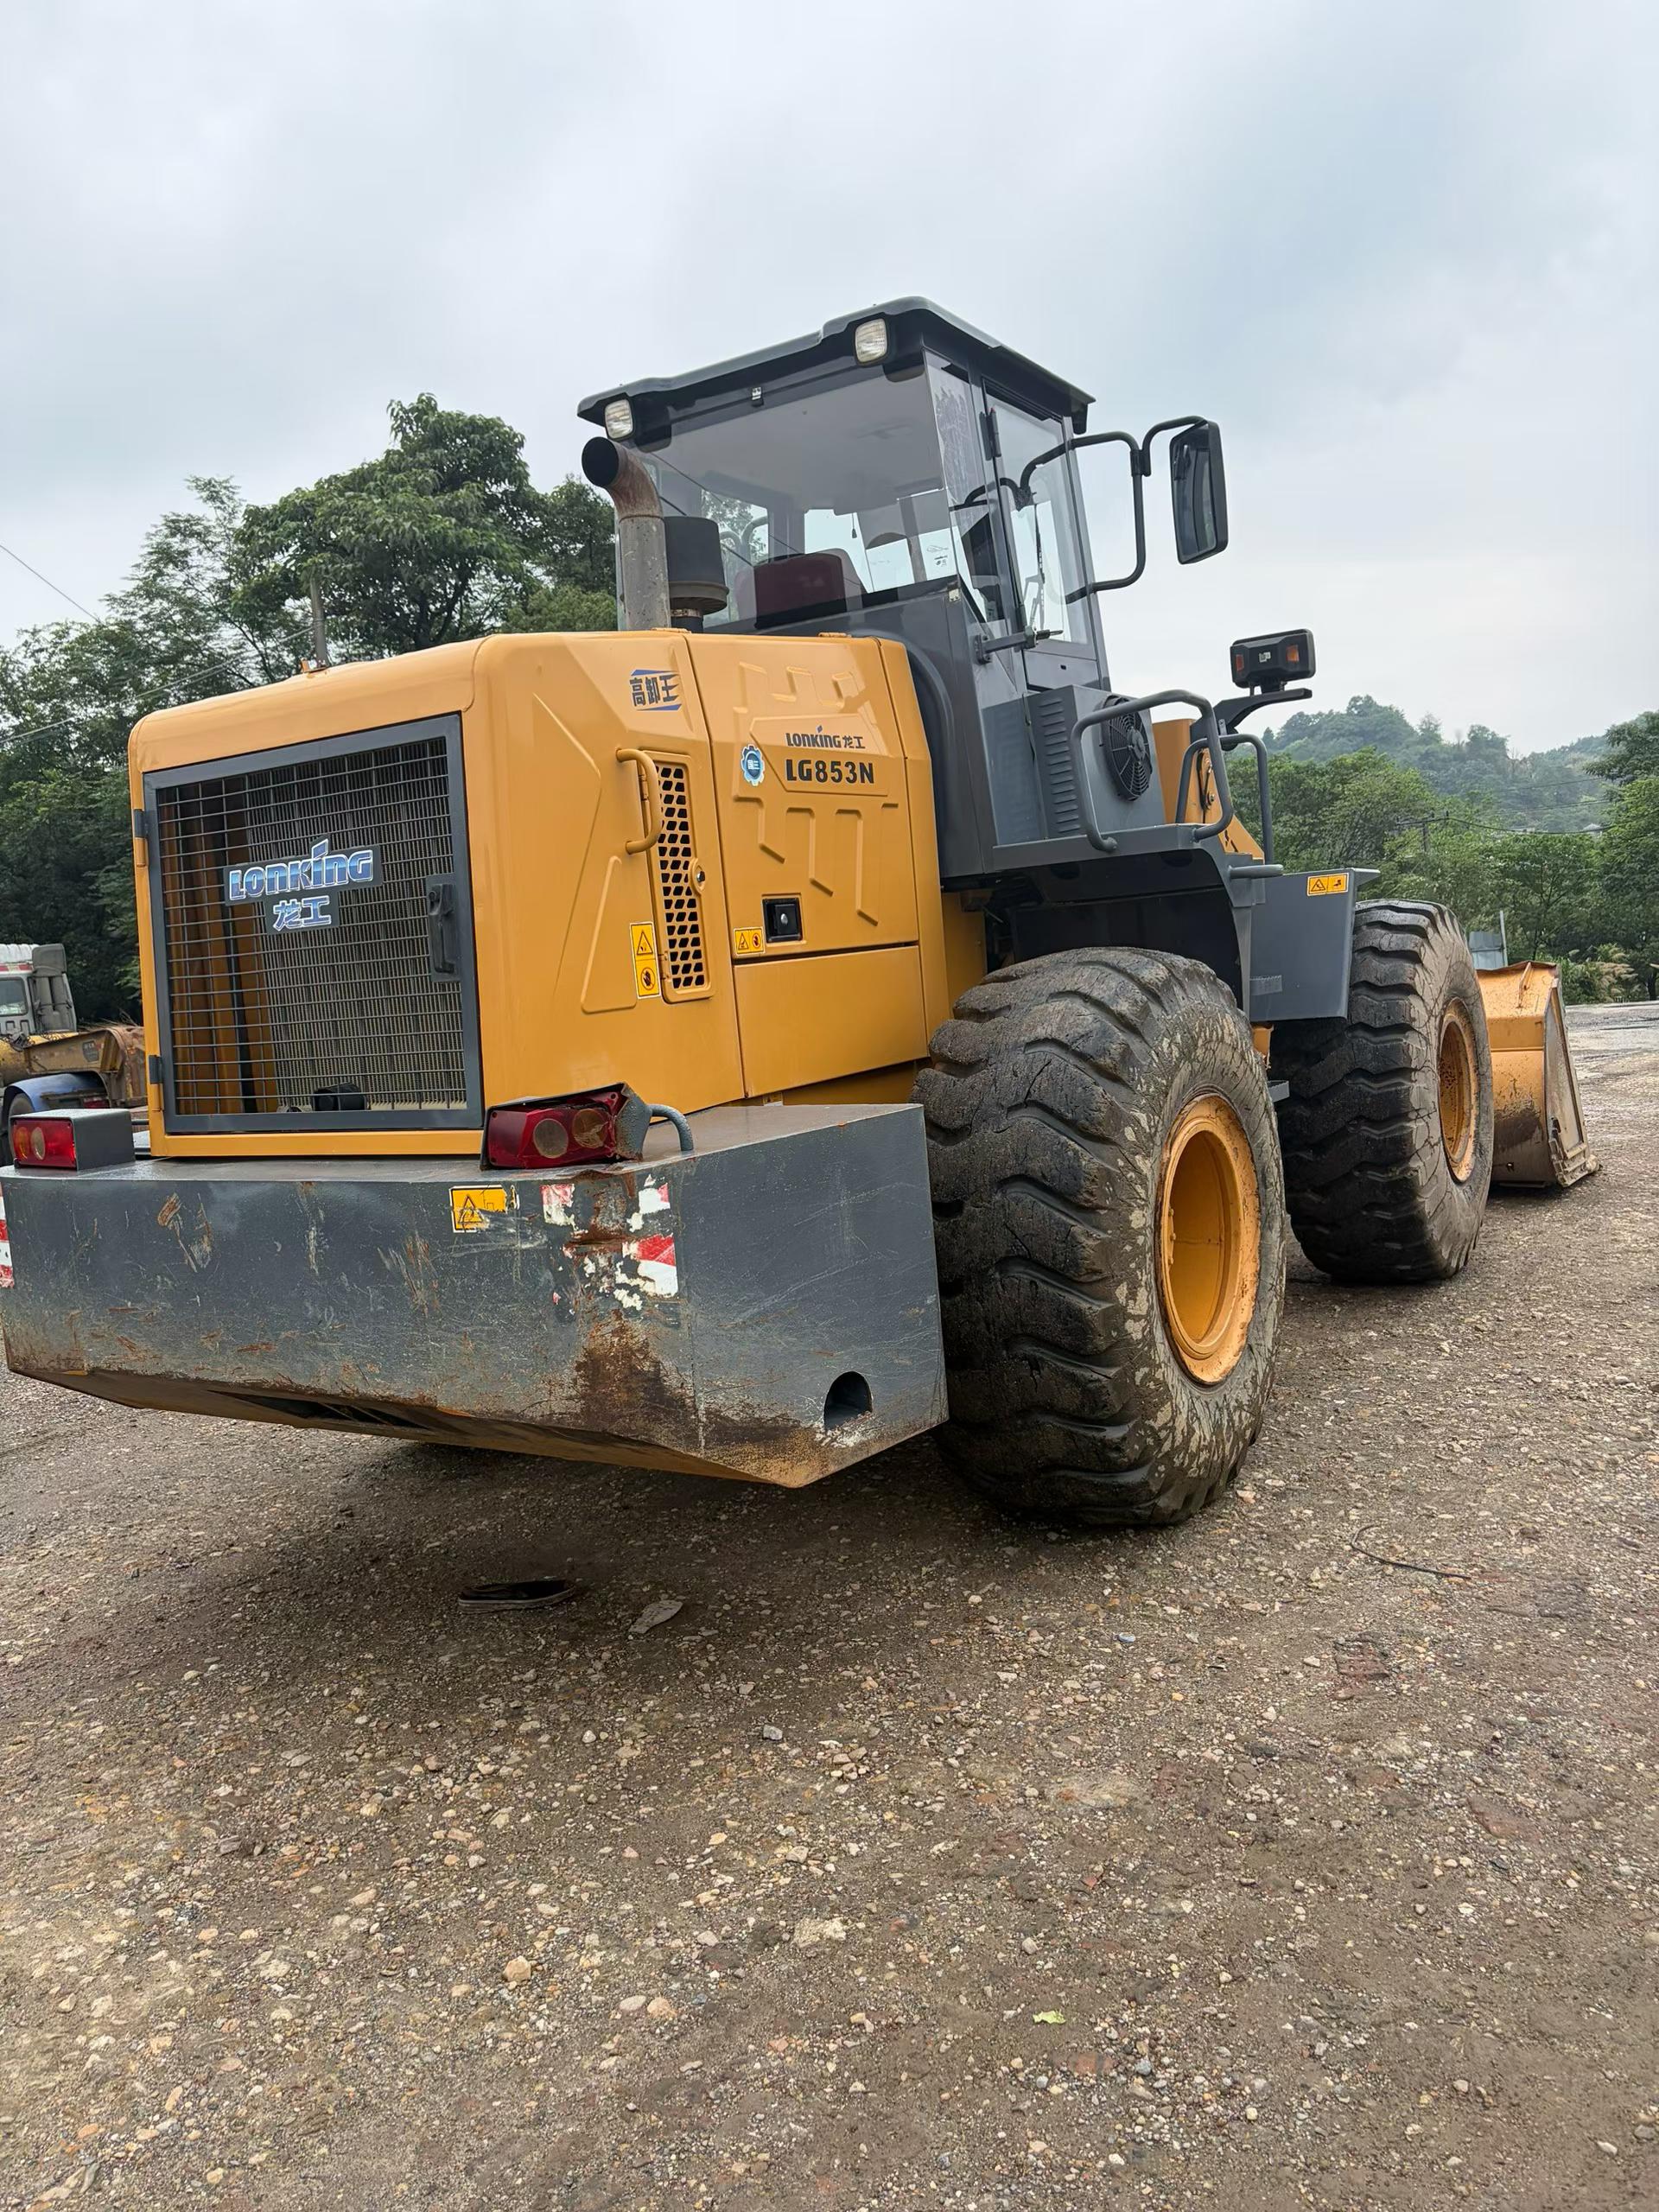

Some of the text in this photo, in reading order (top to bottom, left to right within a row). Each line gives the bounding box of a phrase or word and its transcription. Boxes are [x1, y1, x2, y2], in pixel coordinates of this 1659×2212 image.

[842, 734, 866, 749] 龙工
[785, 759, 875, 785] LG853N
[272, 895, 332, 931] 龙工
